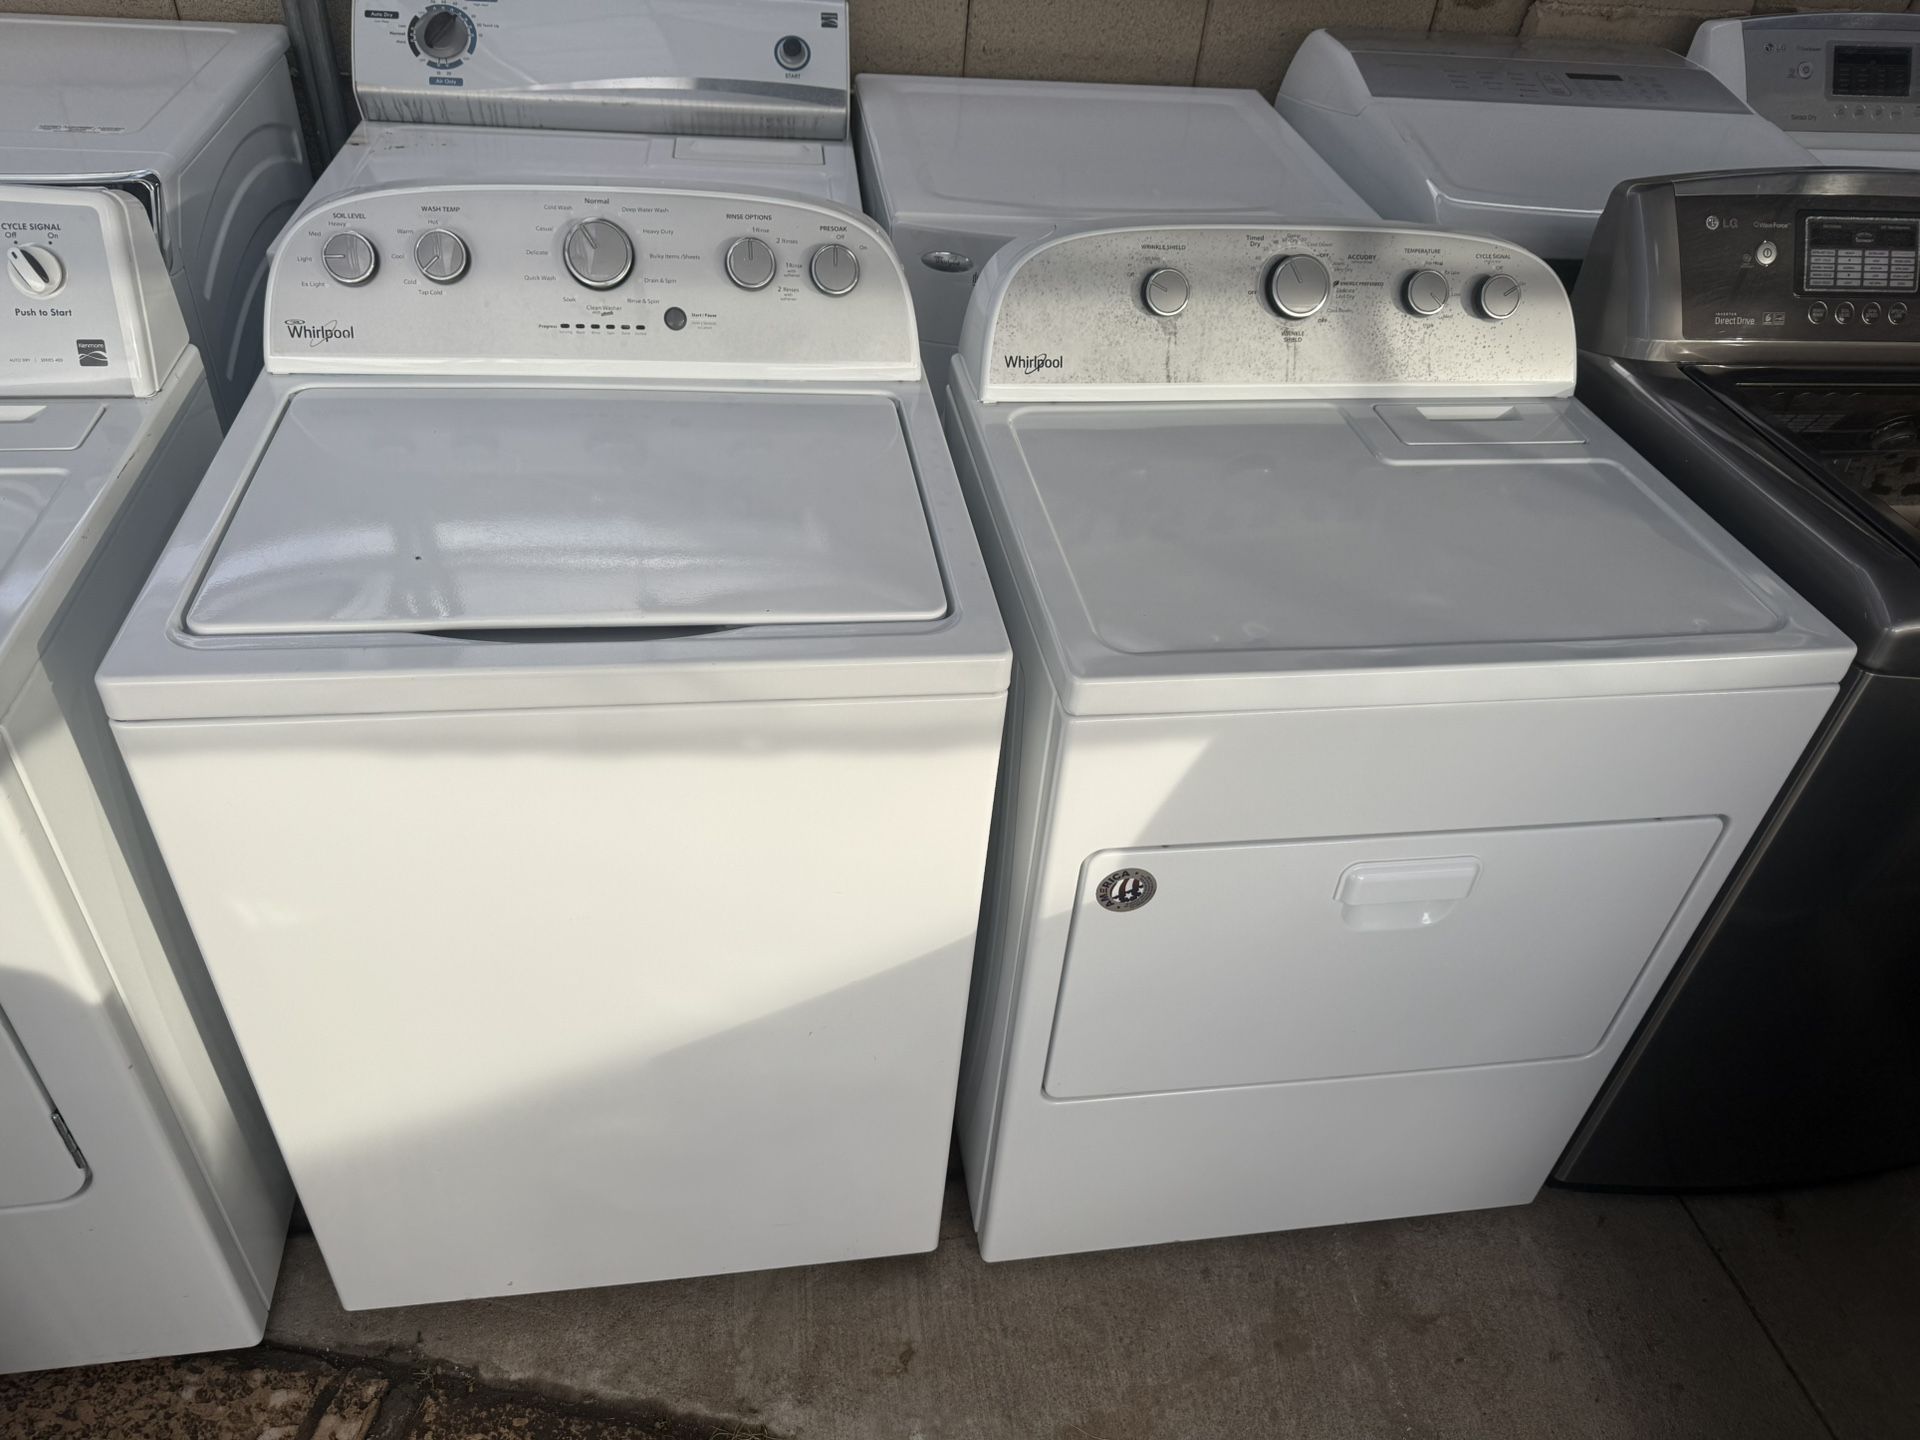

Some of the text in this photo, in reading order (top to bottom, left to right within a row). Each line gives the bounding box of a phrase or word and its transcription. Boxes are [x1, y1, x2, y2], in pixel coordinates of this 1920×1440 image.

[585, 197, 610, 205] Normal
[744, 213, 772, 221] OPTIONS
[1, 223, 61, 231] CYCLE SIGNAL
[1722, 217, 1738, 229] LG
[643, 228, 674, 236] Heavy Duty
[15, 308, 36, 316] Push
[50, 308, 72, 316] Start
[1715, 316, 1755, 325] Direct Drive
[286, 322, 355, 344] Whirlpool
[1004, 354, 1063, 373] Whirlpool
[1099, 870, 1130, 907] AMERICA
